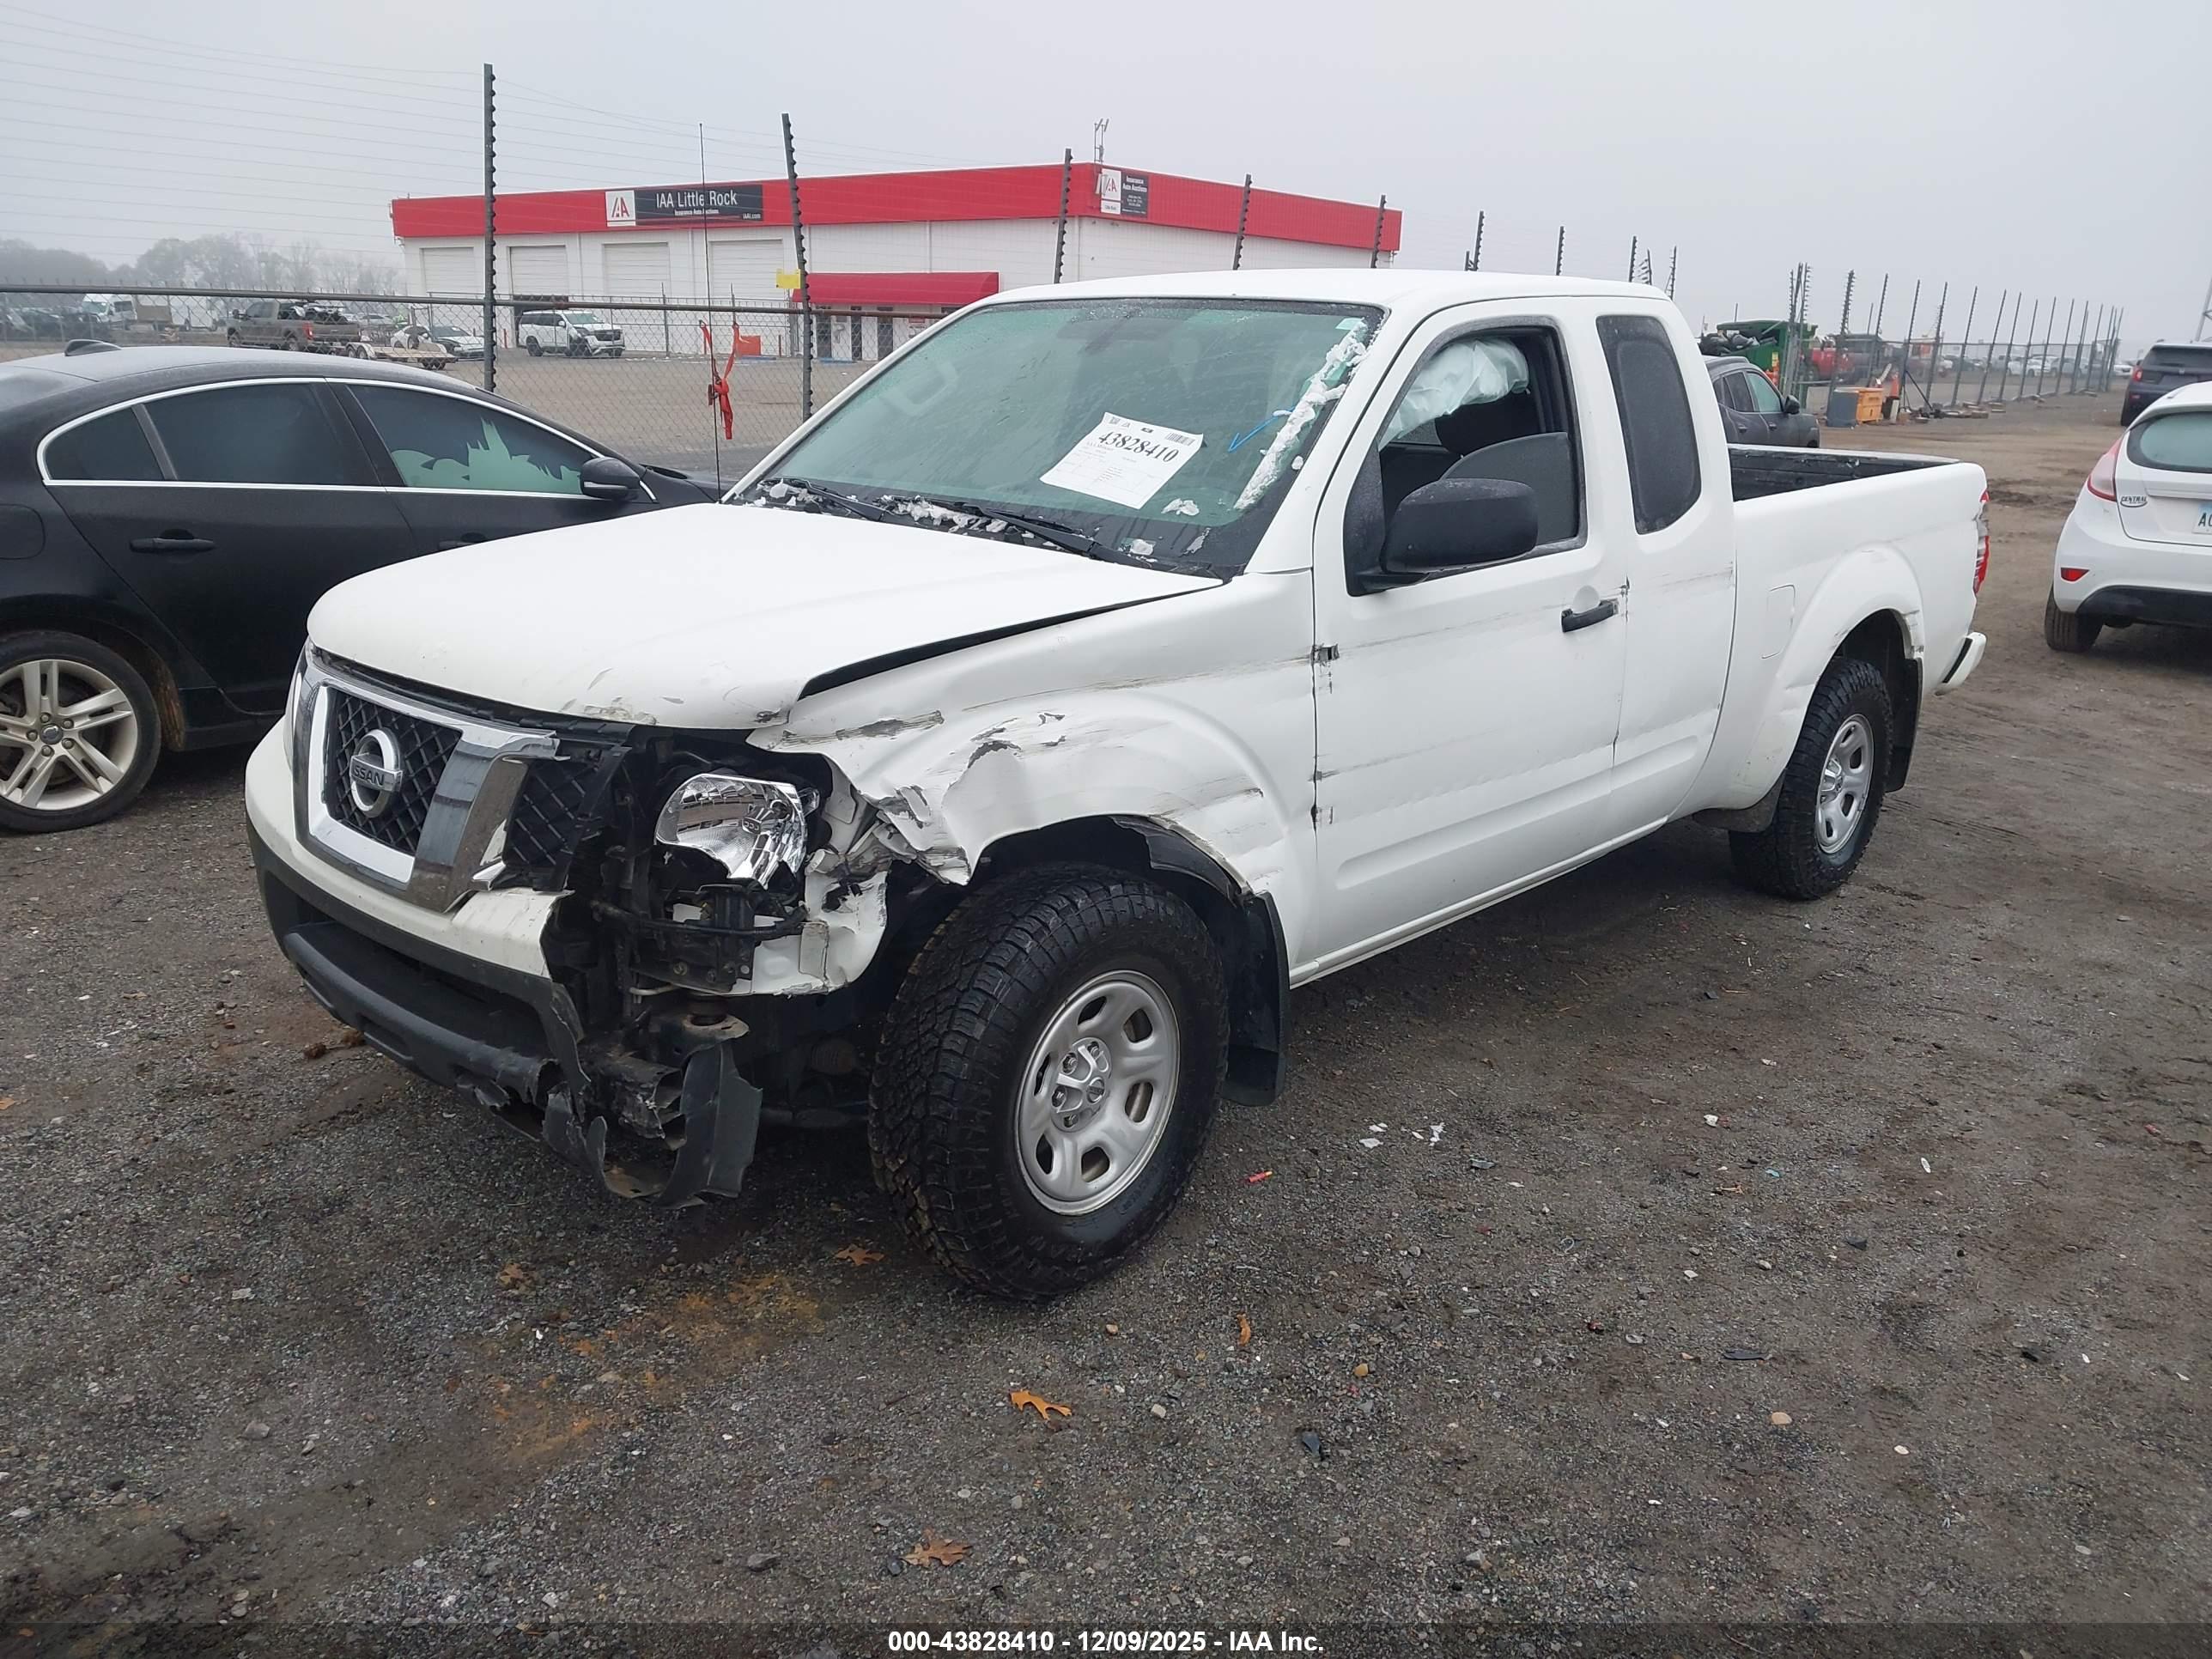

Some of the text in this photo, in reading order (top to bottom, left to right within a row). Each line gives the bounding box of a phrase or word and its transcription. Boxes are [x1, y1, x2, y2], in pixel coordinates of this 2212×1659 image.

[656, 189, 738, 209] IAA Little Rock
[1098, 431, 1179, 462] 43828410
